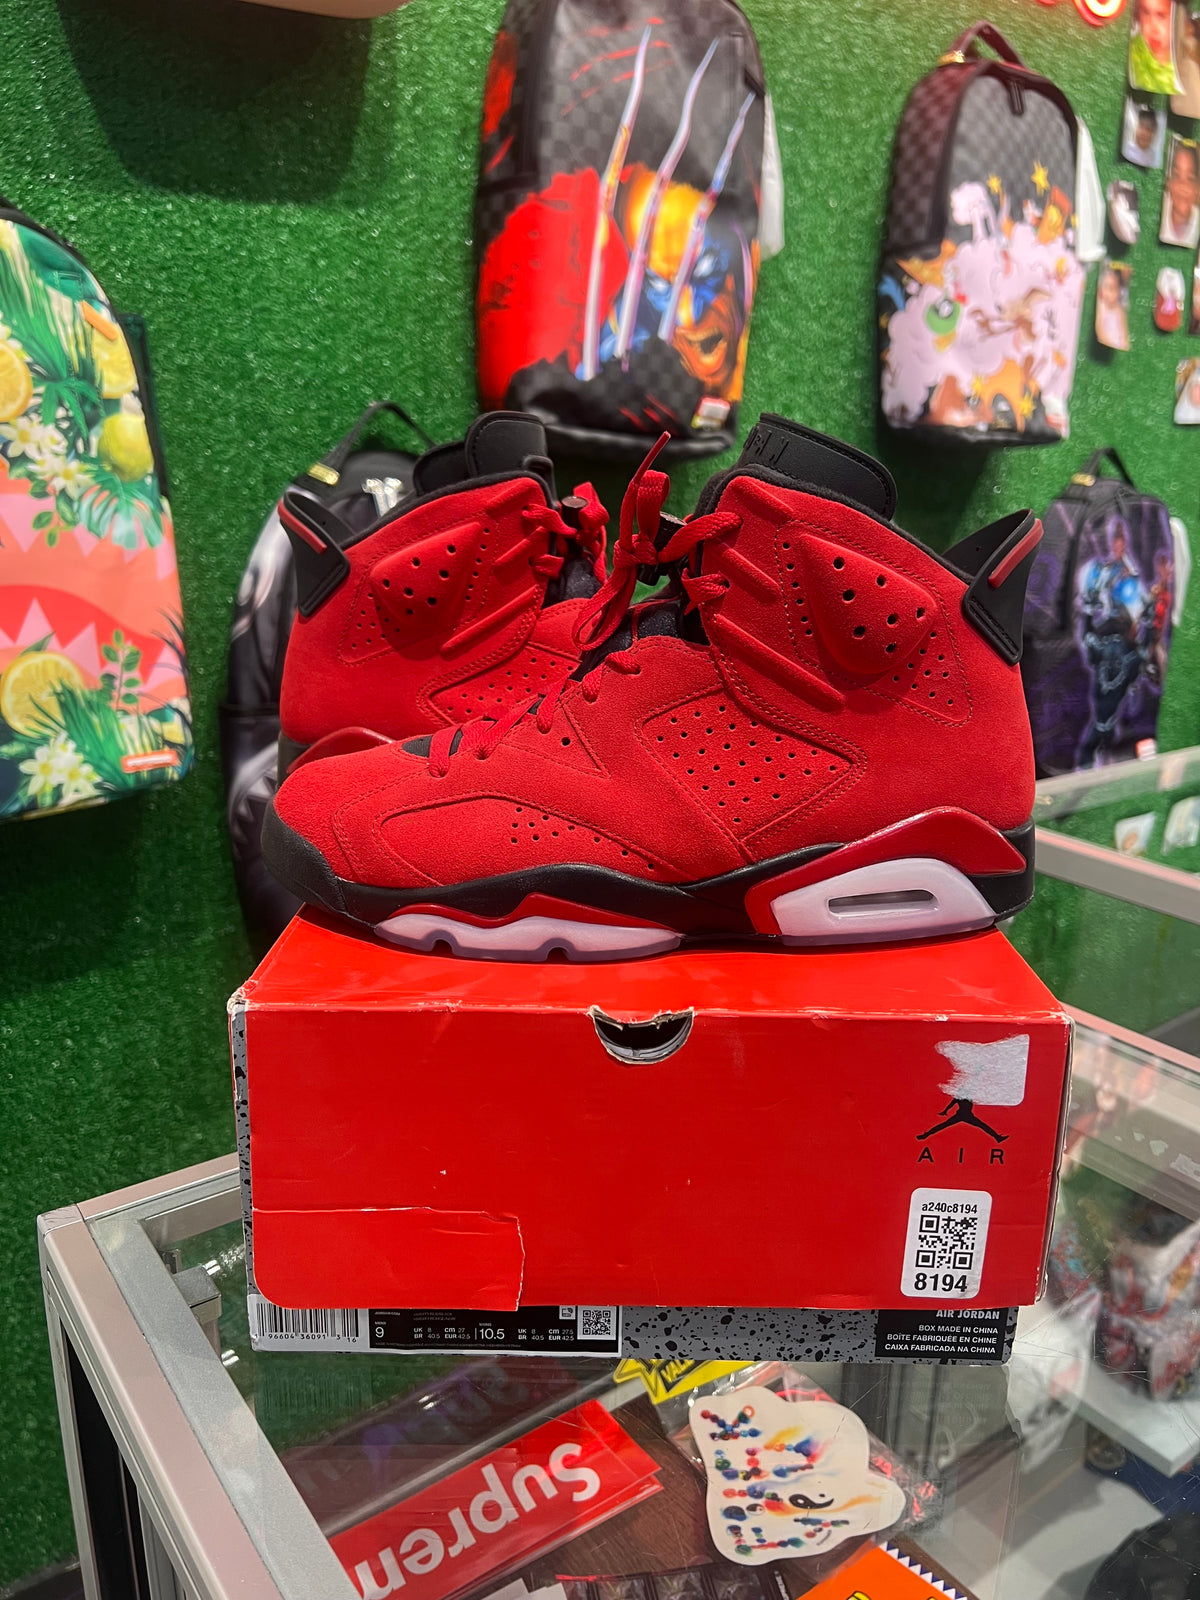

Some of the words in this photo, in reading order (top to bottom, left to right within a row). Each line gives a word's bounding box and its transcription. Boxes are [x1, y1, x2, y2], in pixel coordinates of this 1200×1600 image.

[917, 1147, 1005, 1165] AIR
[921, 1202, 978, 1215] a240c8194
[914, 1273, 968, 1293] 8194
[936, 1310, 954, 1318] AIR
[957, 1310, 1000, 1320] JORDAN
[375, 1325, 385, 1338] 9
[479, 1328, 505, 1340] 10.5
[918, 1324, 936, 1332] BOX
[937, 1325, 961, 1333] MADE
[962, 1326, 972, 1334] IN
[887, 1332, 911, 1341] BOÎTE
[912, 1334, 958, 1343] FABRIQUÉE
[885, 1343, 909, 1351] CAIXA
[910, 1344, 956, 1352] FABRICADA
[970, 1346, 996, 1354] CHINA
